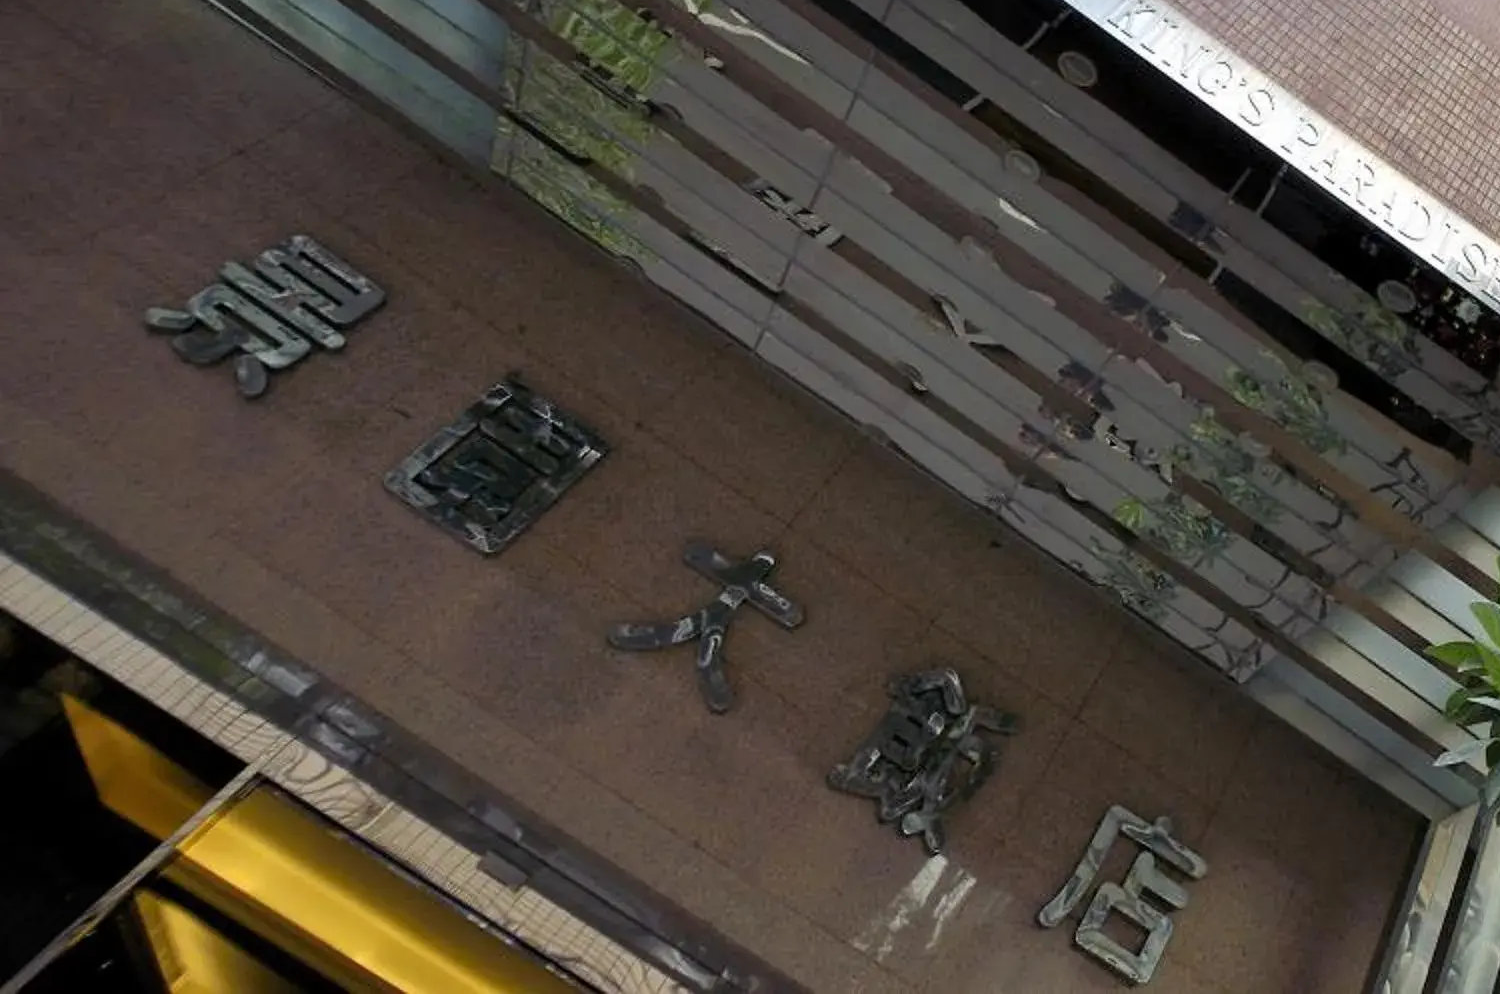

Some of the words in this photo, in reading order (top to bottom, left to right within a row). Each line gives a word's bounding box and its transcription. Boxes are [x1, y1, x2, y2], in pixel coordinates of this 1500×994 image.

[145, 234, 1210, 987] 景園大飯店
